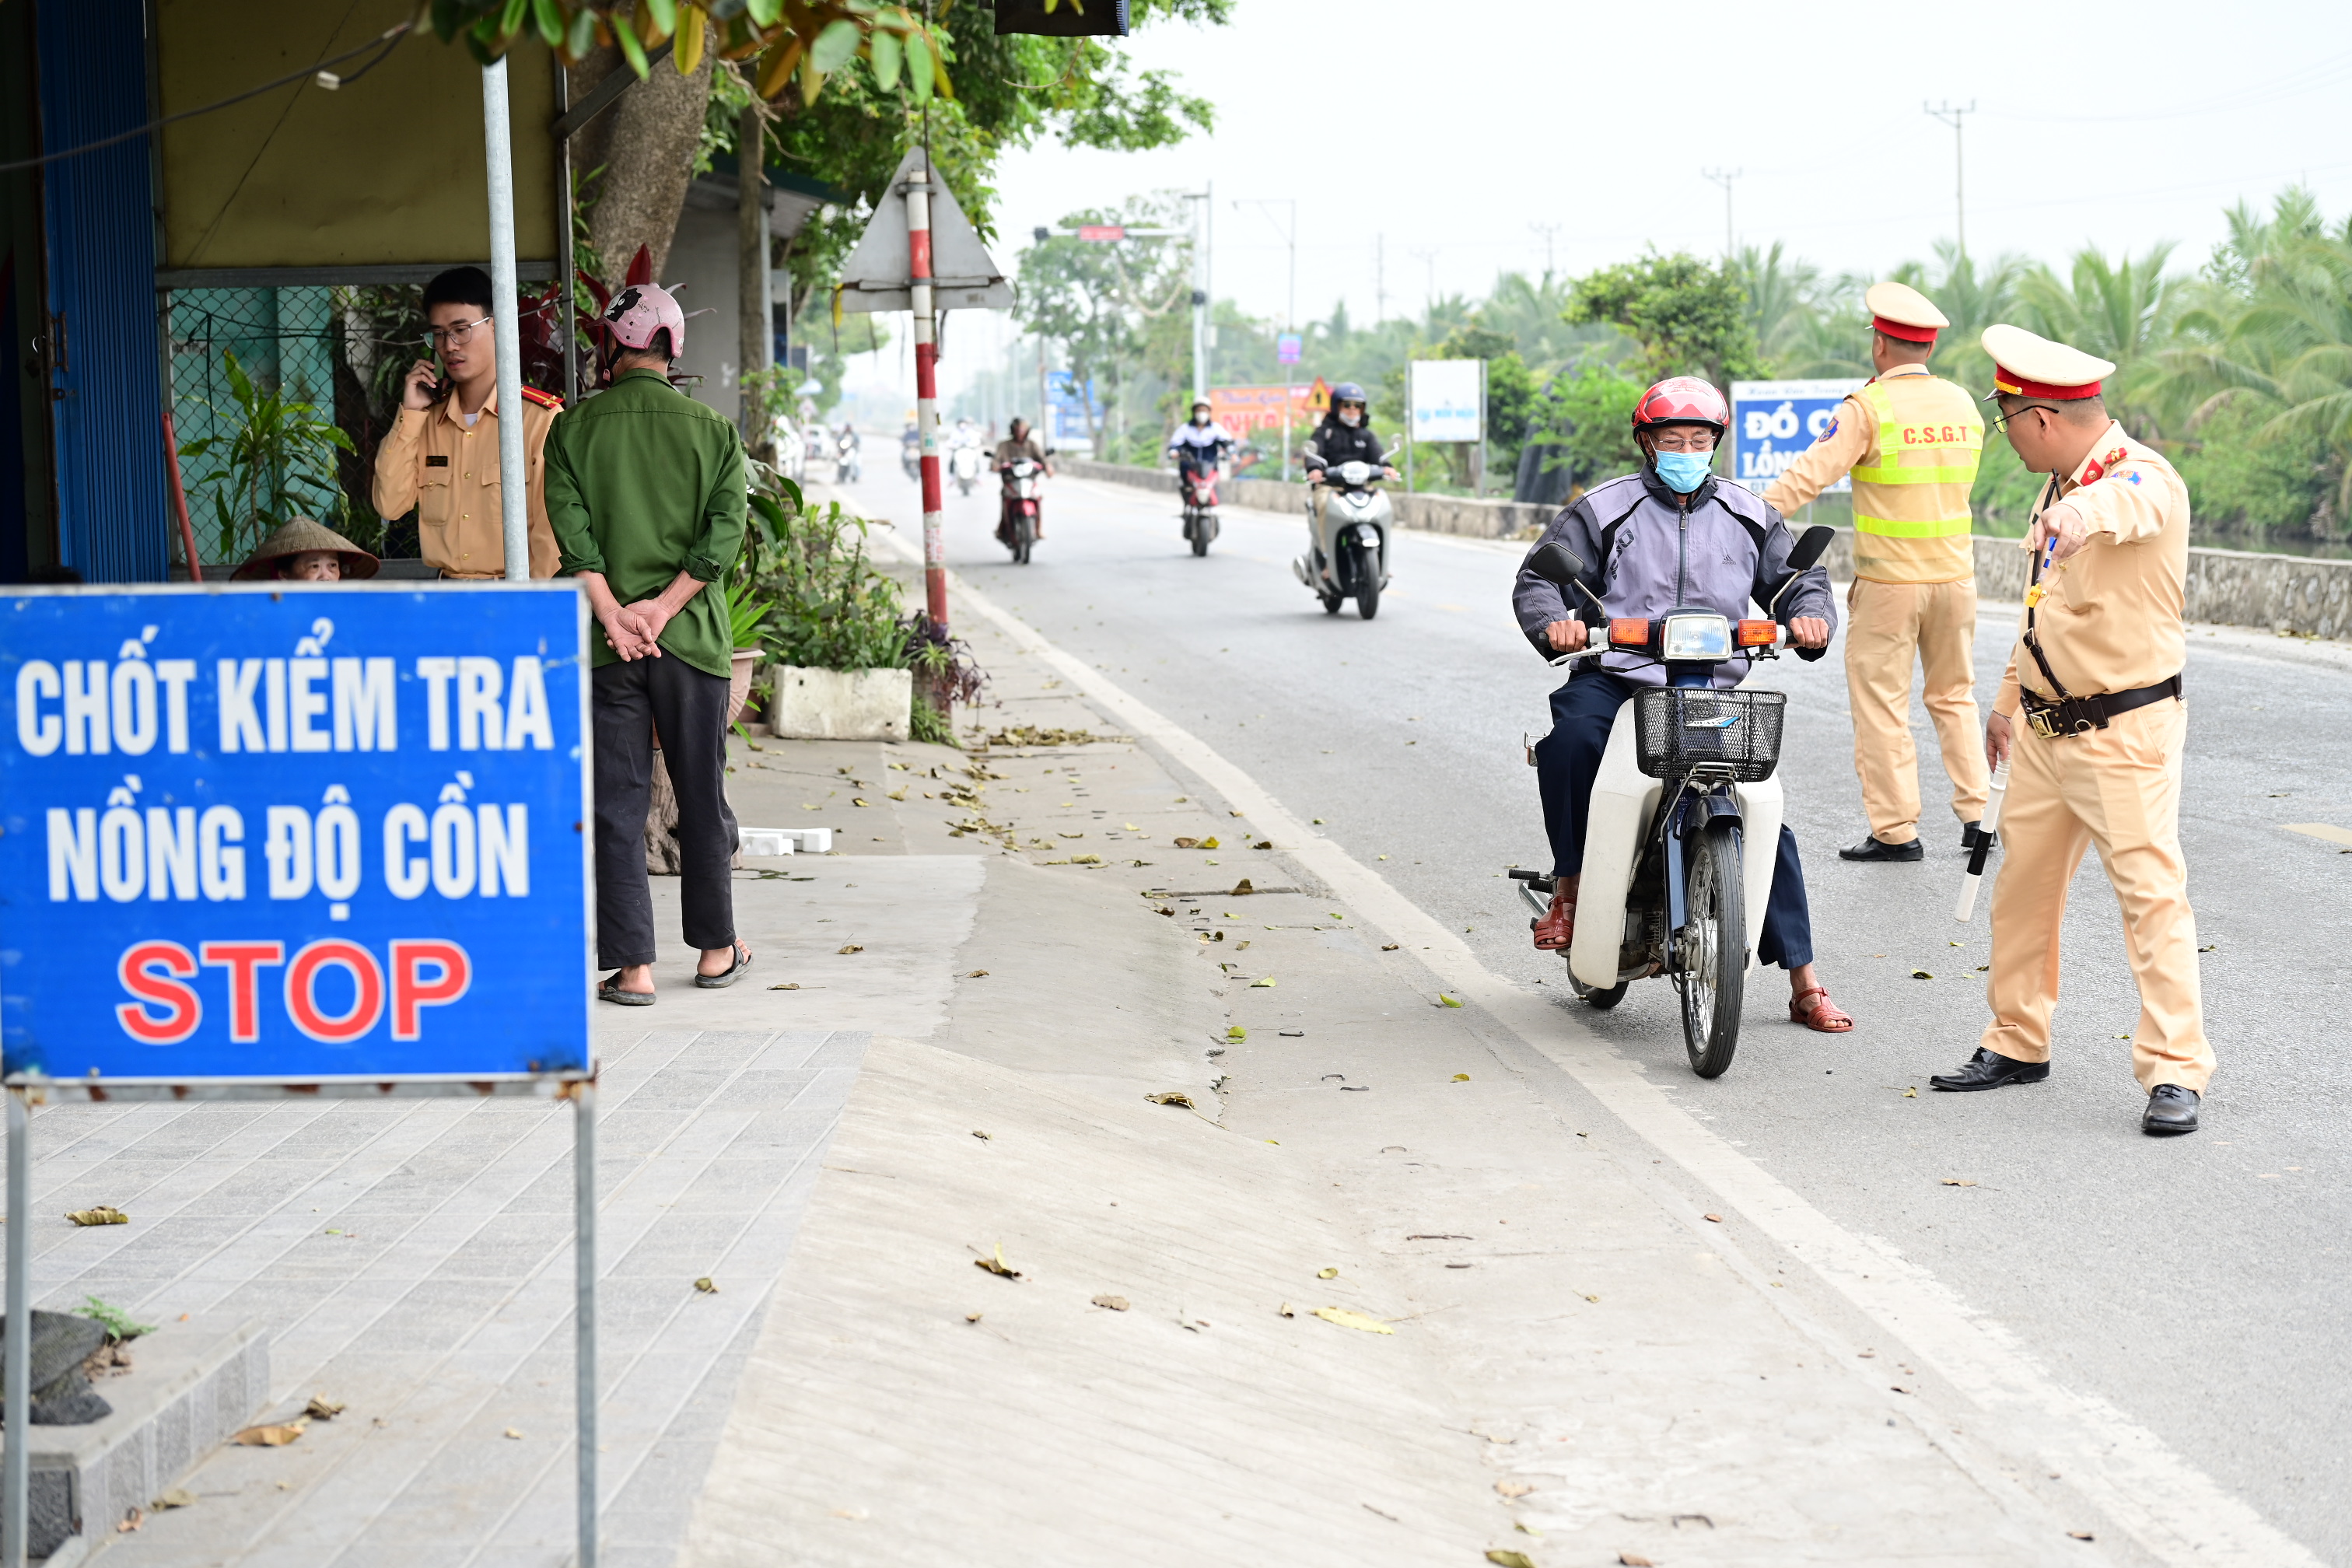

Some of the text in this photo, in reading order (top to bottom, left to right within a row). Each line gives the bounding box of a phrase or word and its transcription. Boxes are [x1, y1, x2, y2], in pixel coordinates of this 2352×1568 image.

[1903, 426, 1967, 444] C.S.G.T
[15, 617, 555, 758] CHỐT KIỂM TRA
[46, 770, 530, 922] NỒNG ĐỘ CỒN
[115, 938, 473, 1046] STOP
